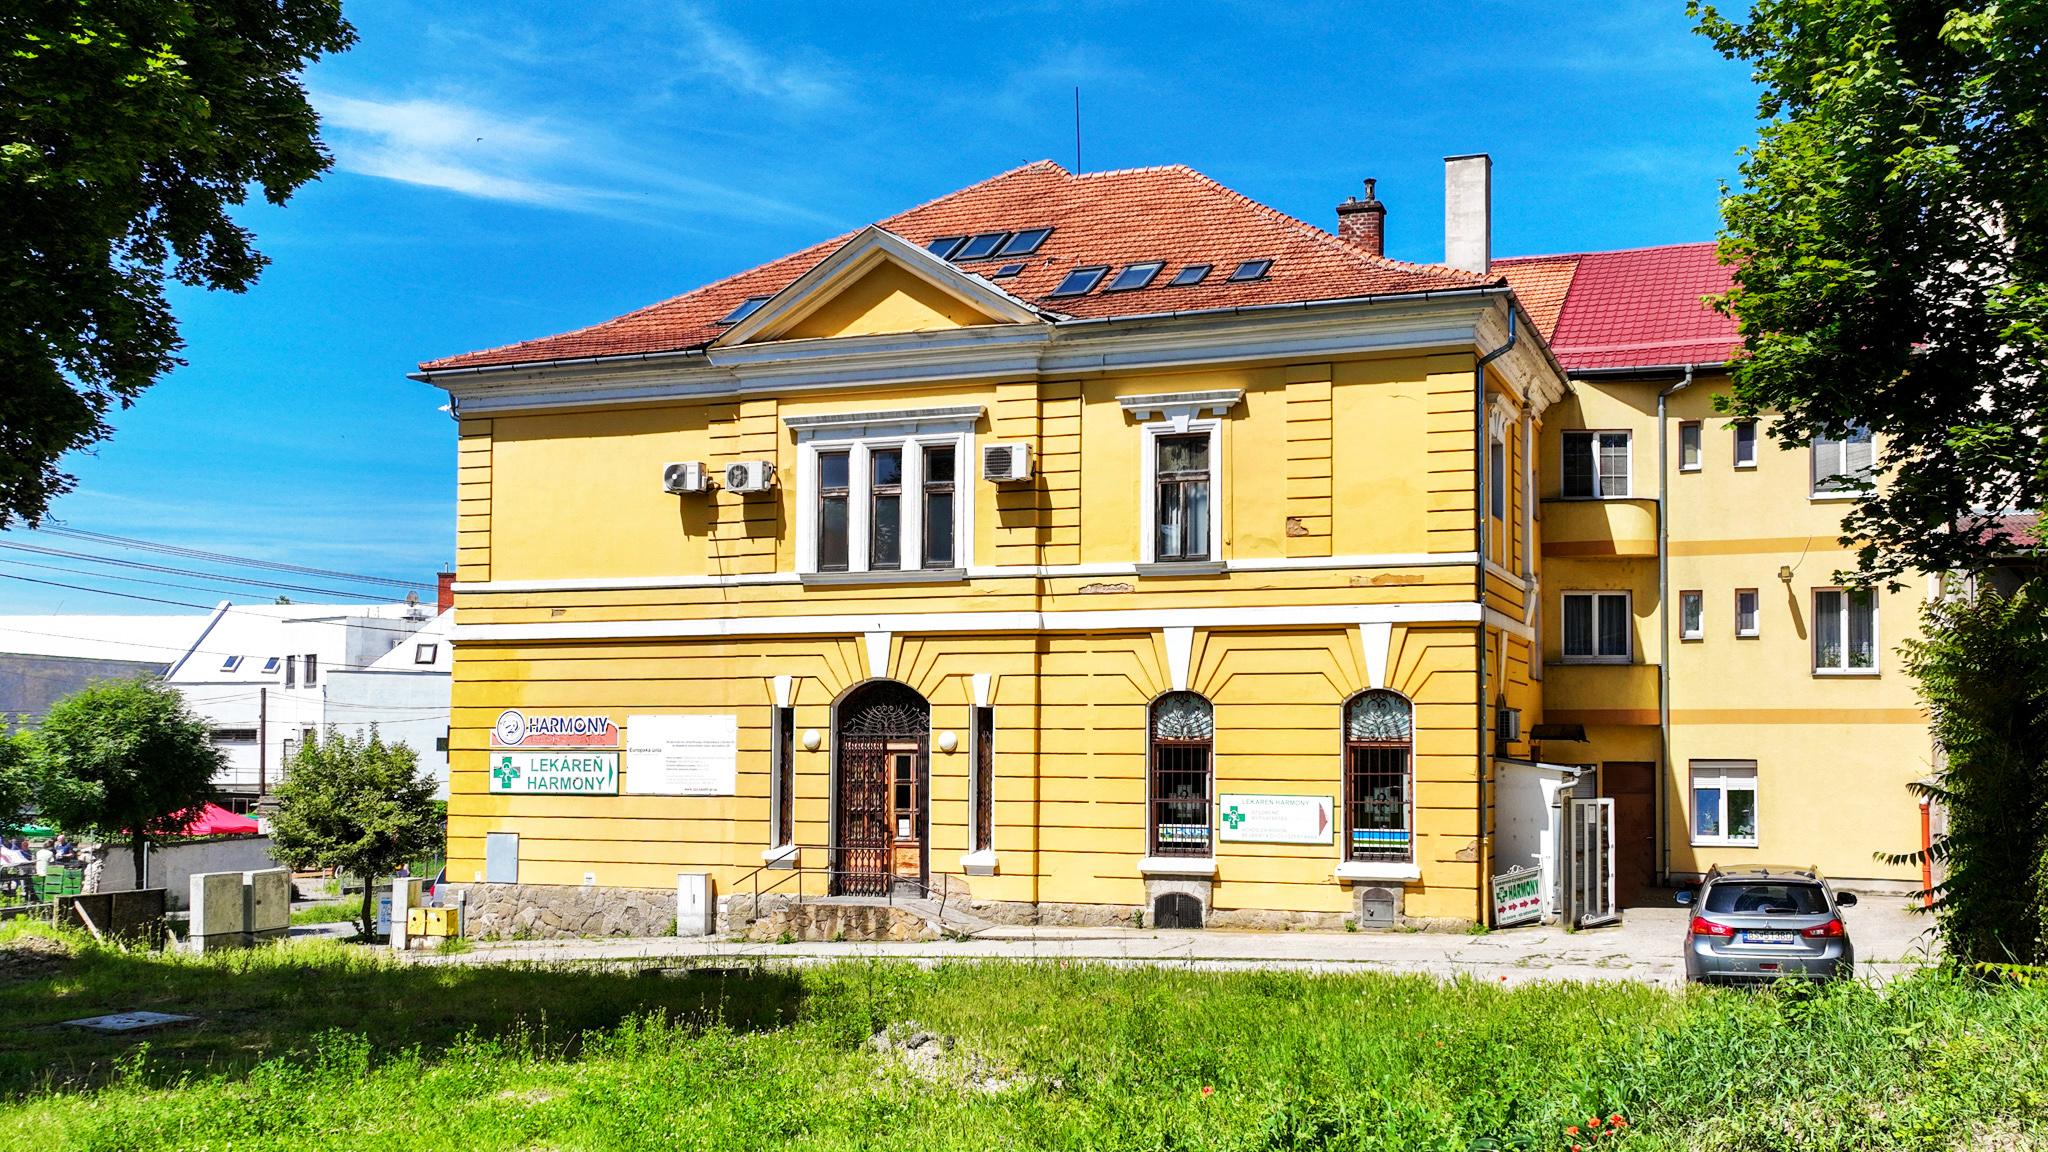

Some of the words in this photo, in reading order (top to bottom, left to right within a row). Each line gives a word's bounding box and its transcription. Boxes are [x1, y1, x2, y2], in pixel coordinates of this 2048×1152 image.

[529, 717, 608, 733] HARMONY
[530, 755, 603, 773] LEKÁREŇ
[527, 777, 606, 791] HARMONY
[1508, 879, 1539, 900] HARMONY
